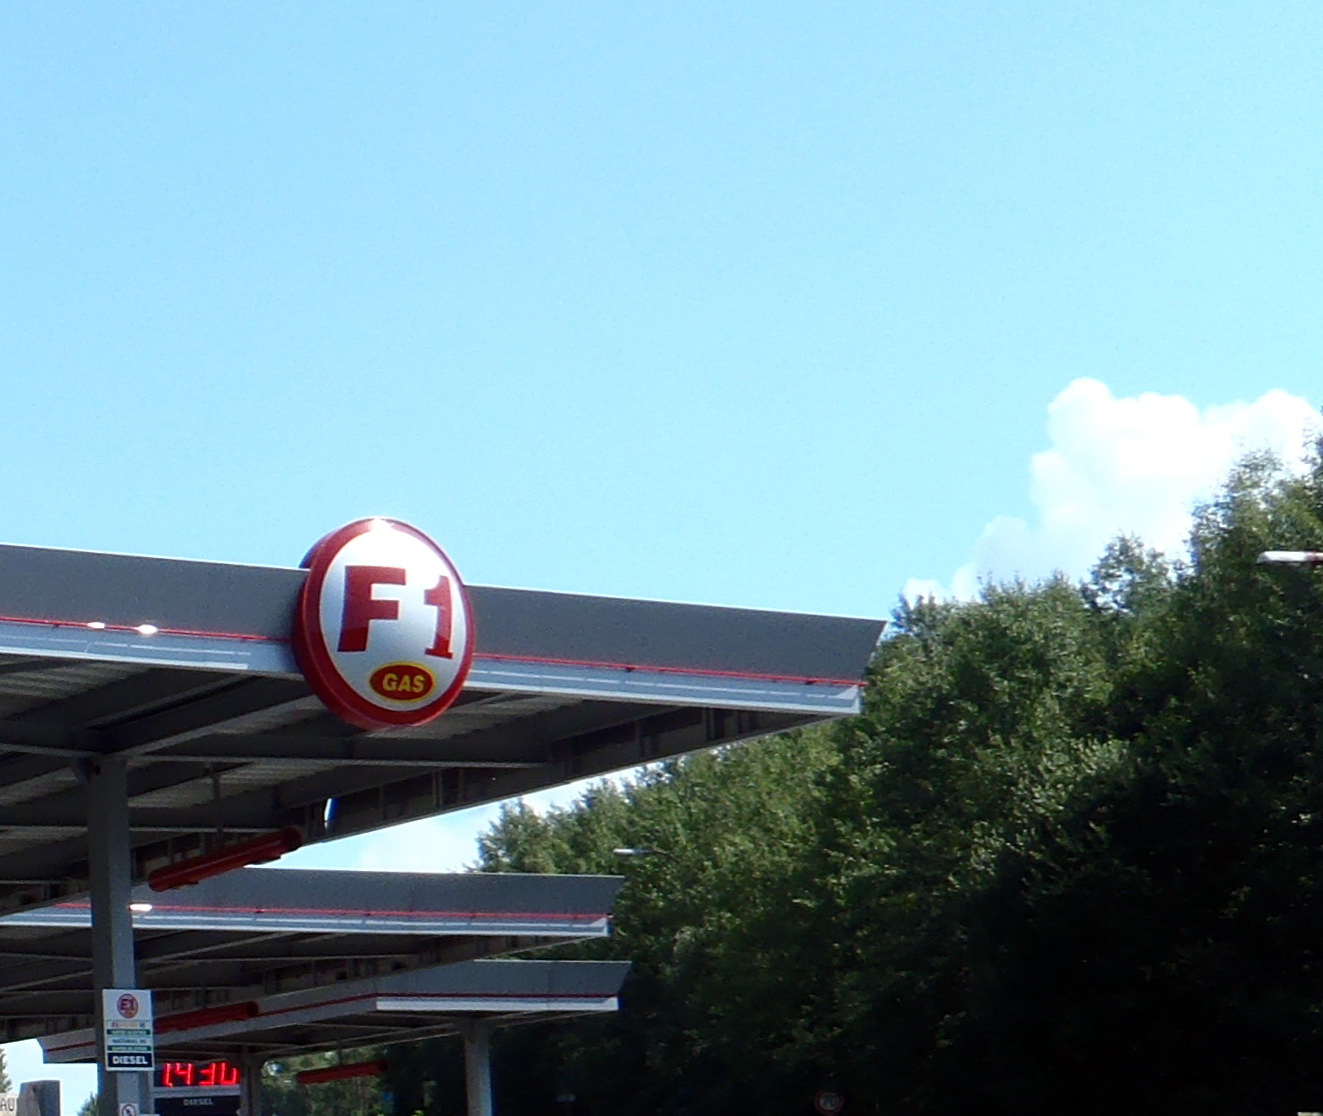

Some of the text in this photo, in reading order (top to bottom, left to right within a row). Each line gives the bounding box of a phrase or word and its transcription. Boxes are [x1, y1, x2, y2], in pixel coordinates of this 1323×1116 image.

[337, 565, 453, 659] F1
[382, 673, 425, 693] GAS
[112, 1056, 149, 1065] DIESEL
[183, 1098, 214, 1106] DIESEL
